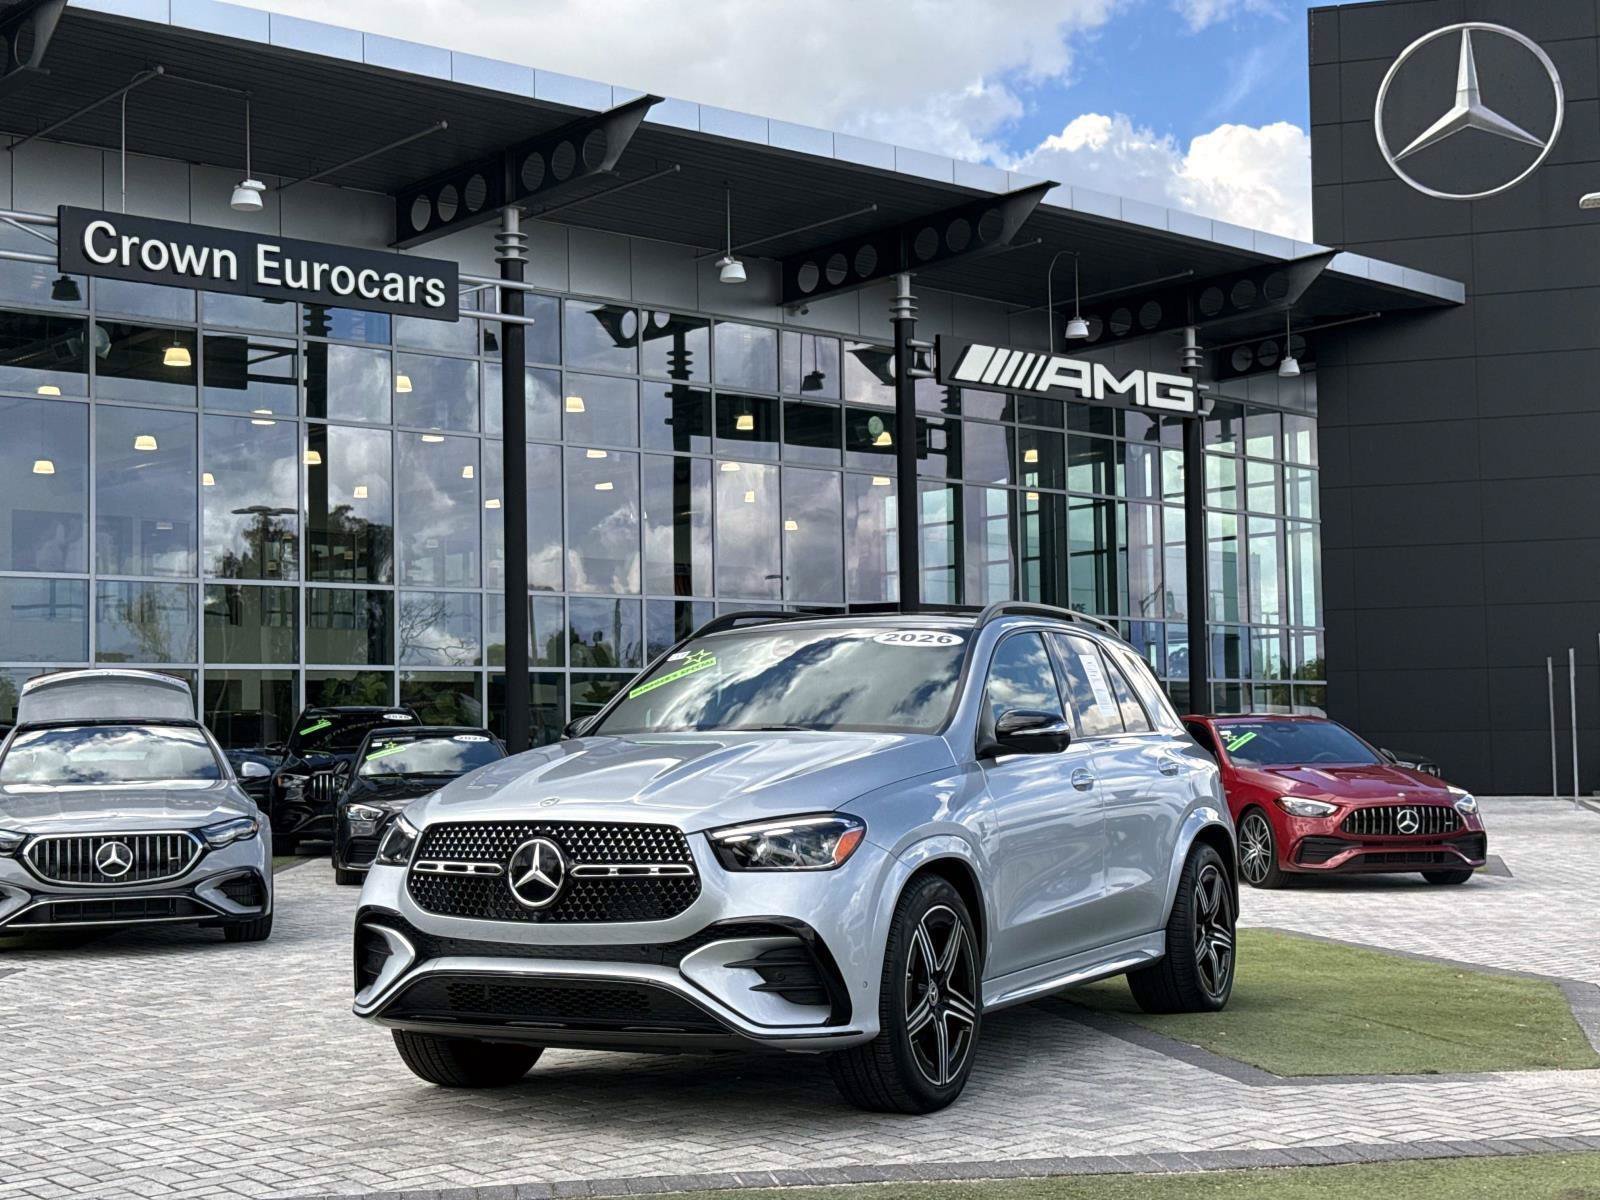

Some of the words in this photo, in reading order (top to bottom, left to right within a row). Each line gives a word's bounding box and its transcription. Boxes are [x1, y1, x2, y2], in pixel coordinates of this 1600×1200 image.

[83, 220, 238, 281] Crown
[256, 243, 447, 308] Eurocars
[1036, 355, 1195, 413] AMG
[882, 633, 953, 644] 2026
